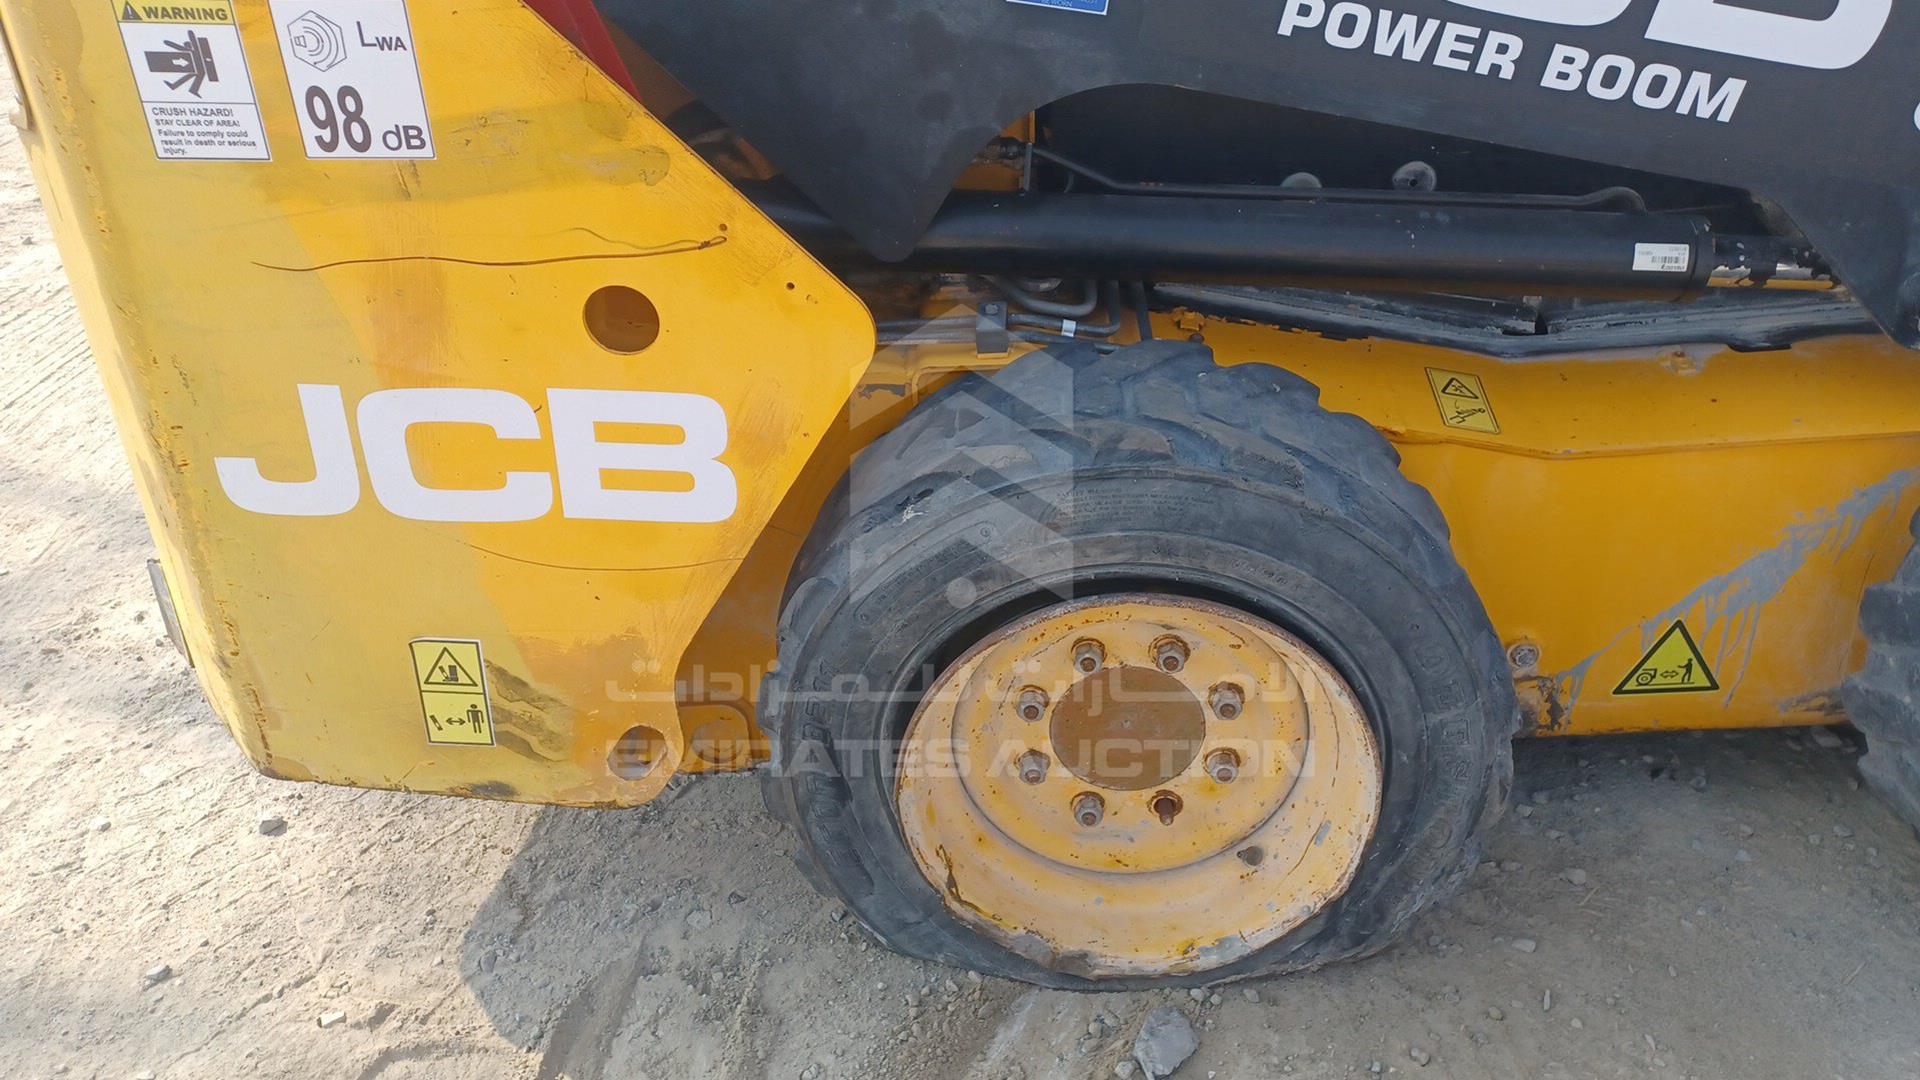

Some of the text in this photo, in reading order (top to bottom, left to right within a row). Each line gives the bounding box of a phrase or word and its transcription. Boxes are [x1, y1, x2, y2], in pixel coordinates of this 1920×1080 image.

[142, 6, 228, 20] WARNING
[1277, 0, 1748, 123] POWER BOOM
[151, 107, 234, 117] CRUSH HAZARD!
[176, 119, 202, 127] CLEAR
[304, 84, 427, 153] 98 dB
[157, 129, 185, 137] Failure
[196, 130, 225, 139] comply
[226, 130, 248, 138] could
[160, 138, 183, 146] result
[194, 139, 216, 147] death
[162, 147, 188, 156] injury.
[214, 383, 738, 523] JCB
